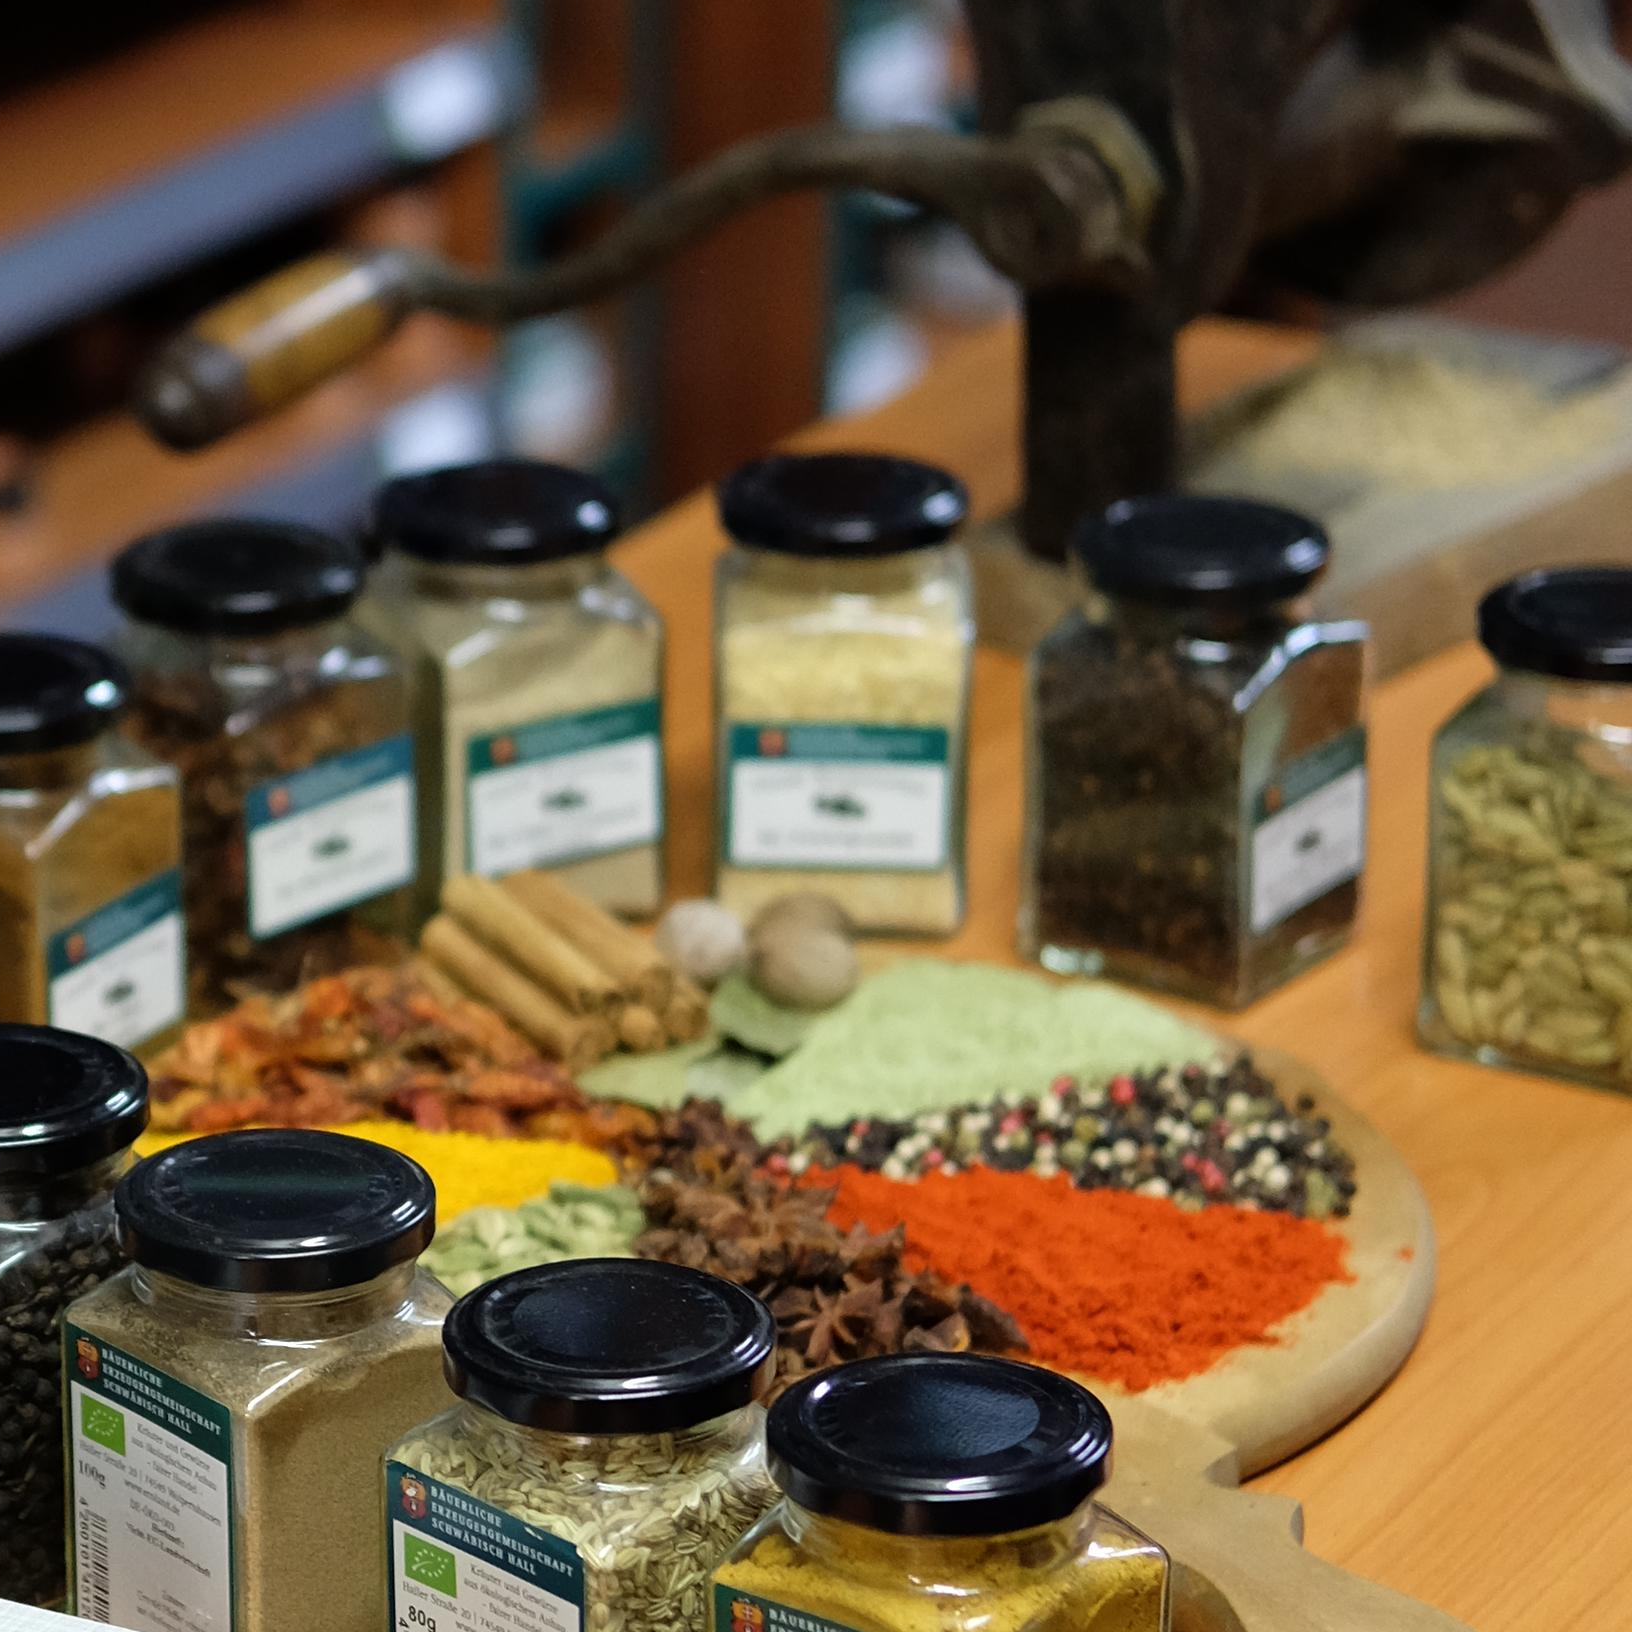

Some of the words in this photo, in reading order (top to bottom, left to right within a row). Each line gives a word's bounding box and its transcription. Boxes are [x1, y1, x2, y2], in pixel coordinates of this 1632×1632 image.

[101, 1345, 162, 1390] BÄUERLICHE
[101, 1360, 221, 1437] ERZEUGERGEMEINSCHAFT
[102, 1374, 164, 1421] SCHWÄBISCH
[168, 1411, 191, 1435] HALL
[77, 1457, 105, 1491] 100g
[430, 1483, 501, 1529] BÄUERLICHE
[431, 1498, 573, 1580] ERZEUGERGEMEINSCHAFT
[431, 1513, 503, 1560] SCHWÄBISCH
[507, 1550, 536, 1576] HALL
[402, 1579, 428, 1602] Haller
[430, 1591, 458, 1615] Straße
[459, 1606, 471, 1622] 20
[503, 1578, 520, 1596] und
[398, 1615, 409, 1630] 4
